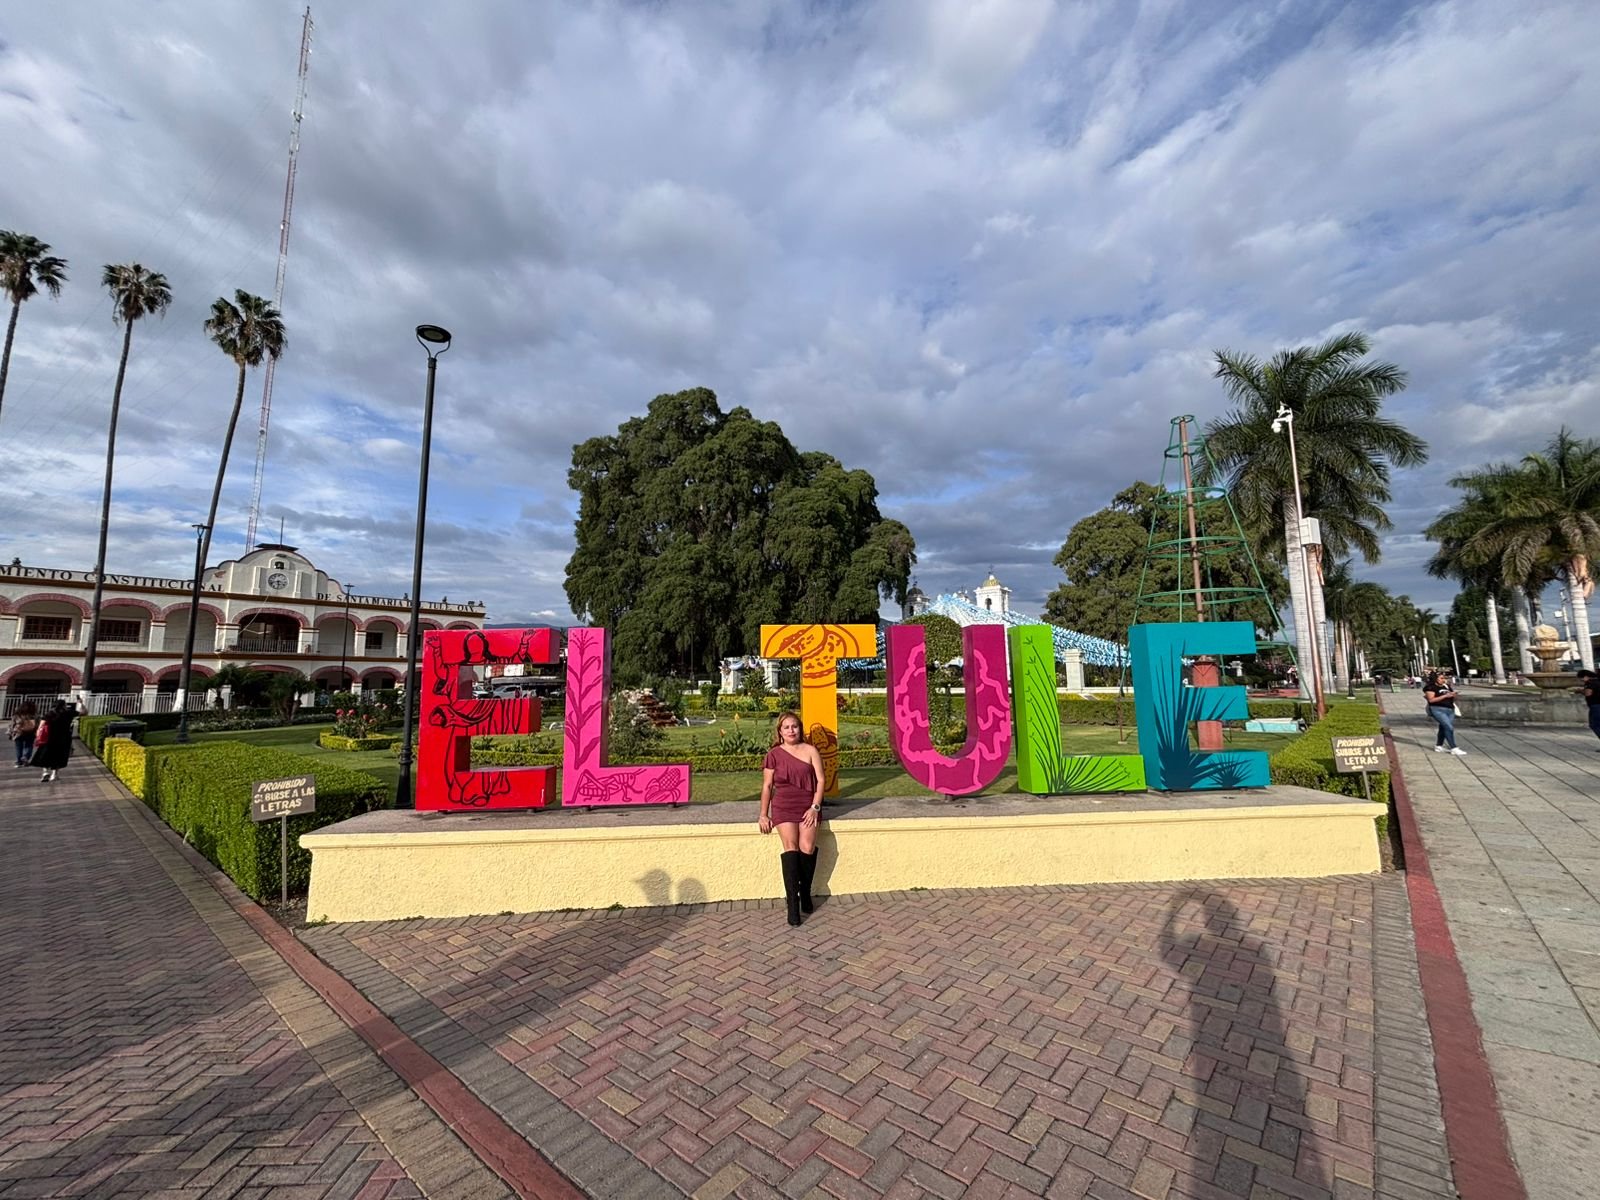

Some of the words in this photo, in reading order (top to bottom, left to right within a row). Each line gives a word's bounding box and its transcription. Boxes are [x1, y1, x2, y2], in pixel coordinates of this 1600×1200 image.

[317, 592, 331, 600] DE
[337, 595, 370, 604] SANTA
[372, 597, 403, 606] MARIA
[415, 627, 692, 811] EL
[760, 621, 1271, 798] TULE
[1337, 738, 1374, 747] PROHIBIDO
[1364, 747, 1370, 755] A
[1371, 746, 1386, 754] LAS
[1344, 756, 1378, 765] LETRAS
[258, 778, 306, 792] PROHIBIDO
[292, 789, 299, 798] A
[301, 786, 315, 796] LAS
[261, 798, 302, 812] LETRAS
